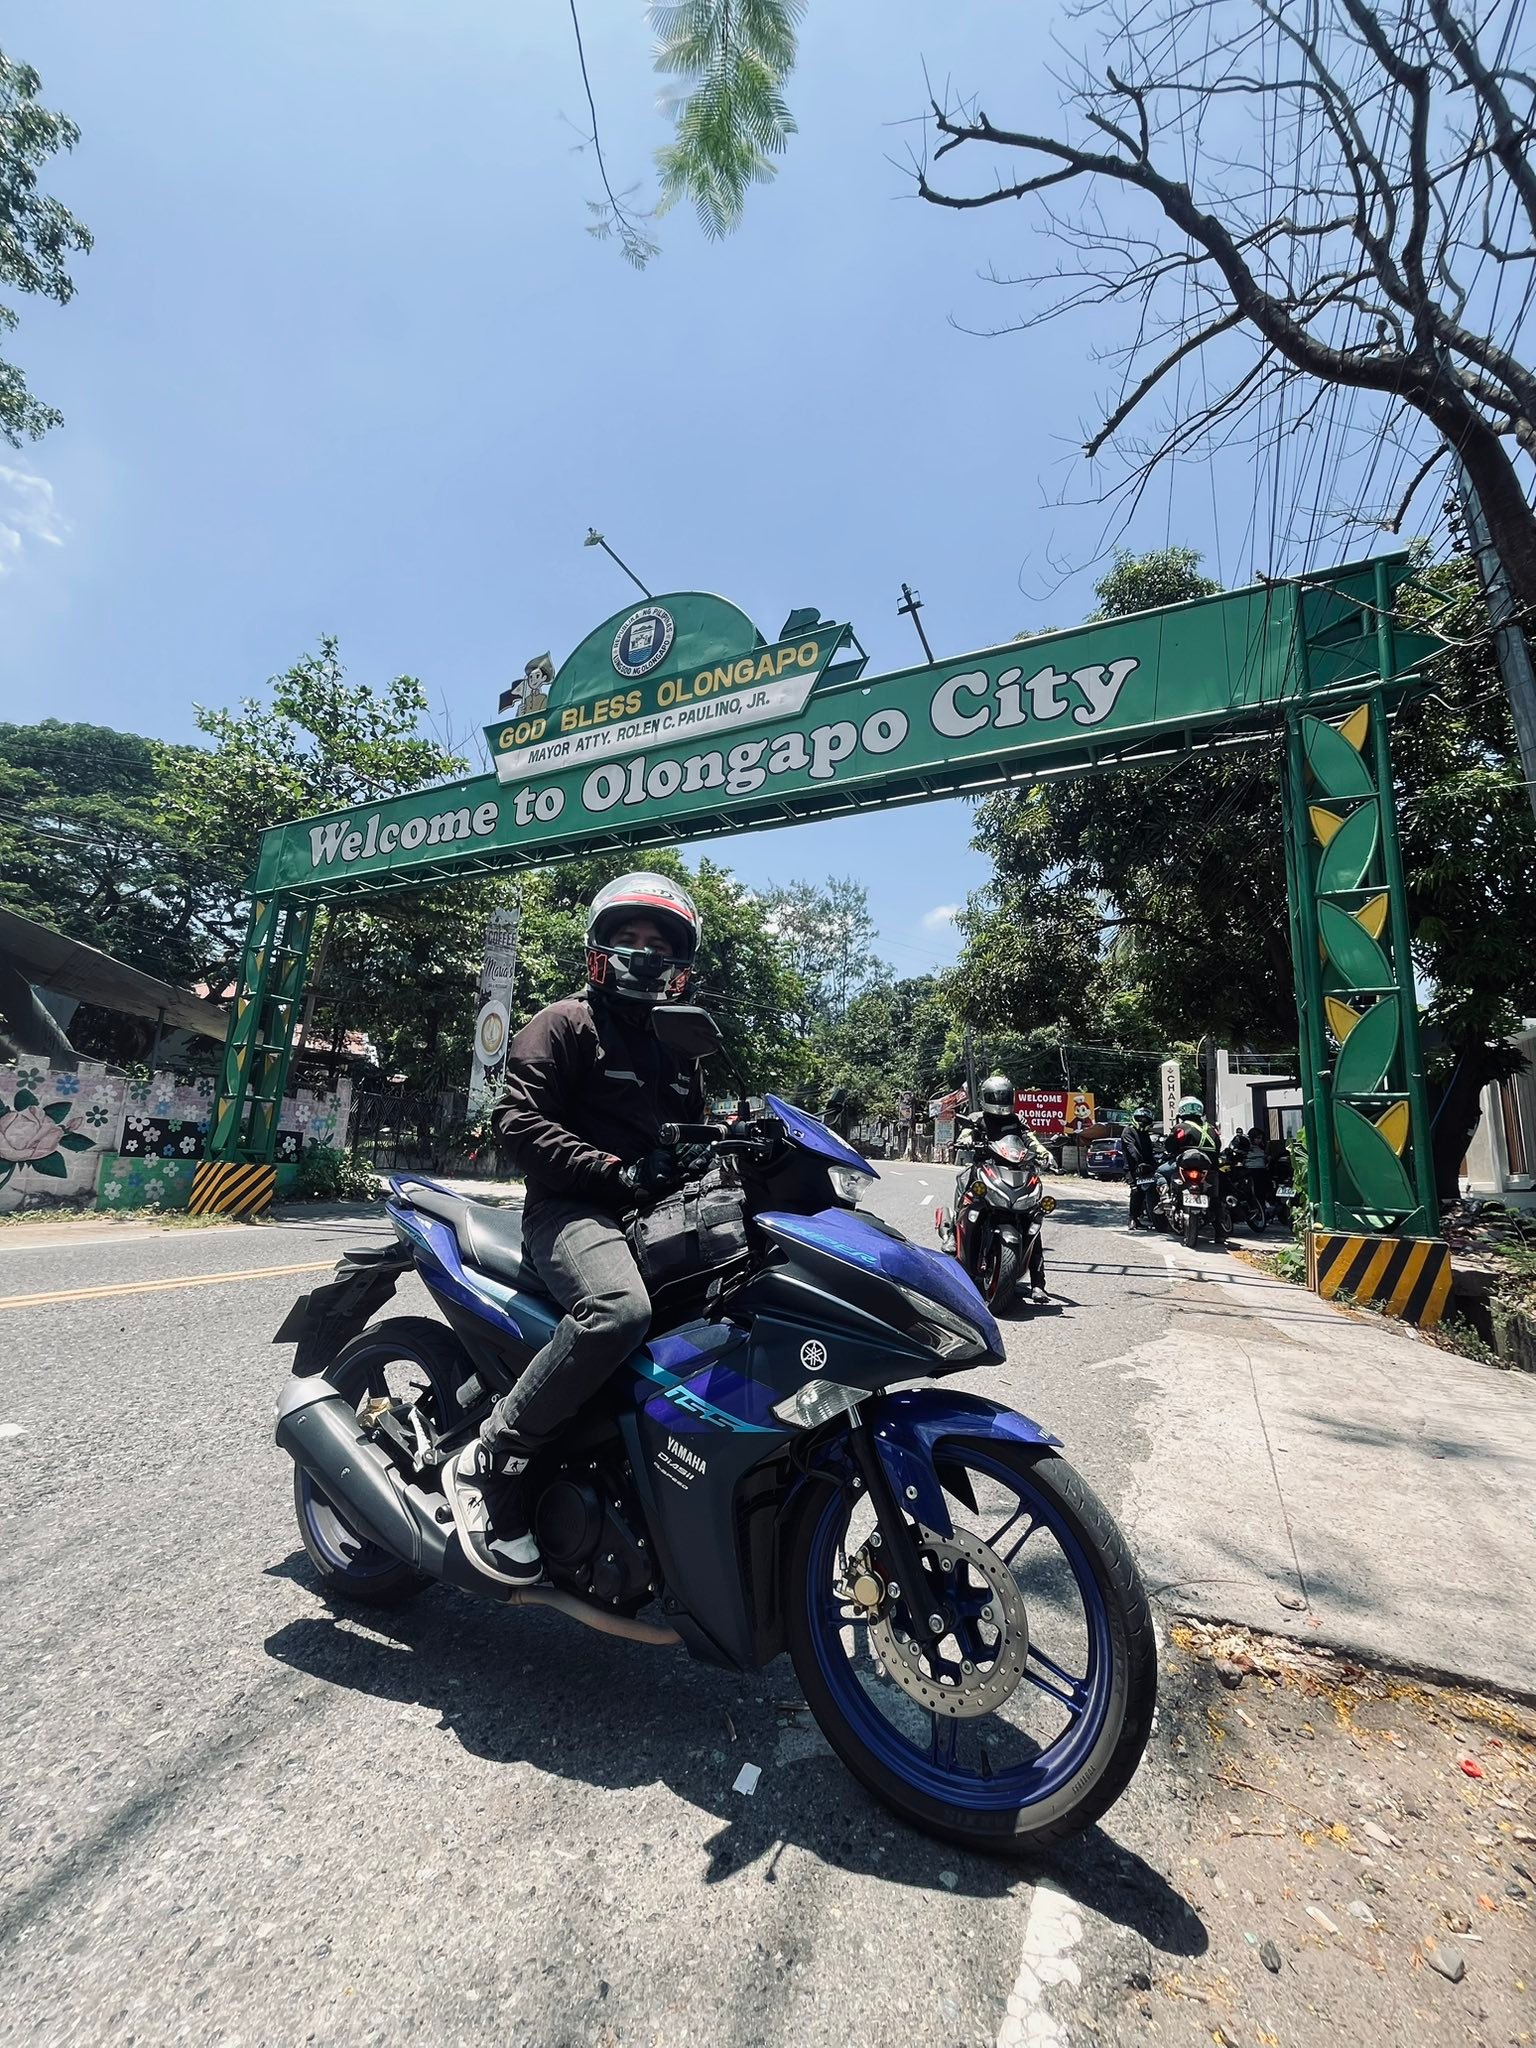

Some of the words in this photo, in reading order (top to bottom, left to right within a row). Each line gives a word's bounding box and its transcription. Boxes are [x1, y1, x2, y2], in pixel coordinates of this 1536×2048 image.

[641, 640, 670, 672] OLONGAPO
[498, 718, 547, 749] GOD
[560, 690, 642, 732] BLESS
[657, 641, 819, 708] OLONGAPO
[527, 741, 570, 764] MAYOR
[575, 730, 611, 752] ATTY.
[616, 718, 661, 742] ROLEN
[662, 716, 676, 730] C.
[677, 697, 743, 727] PAULINO,
[746, 691, 771, 709] JR.
[308, 801, 500, 868] Welcome
[512, 786, 567, 826] to
[581, 708, 910, 813] Olongapo
[930, 657, 1141, 738] City
[1018, 1093, 1063, 1103] WELCOME
[1018, 1109, 1064, 1119] OLONGAPO
[1031, 1118, 1051, 1127] CITY
[667, 1435, 707, 1475] YAMAHA
